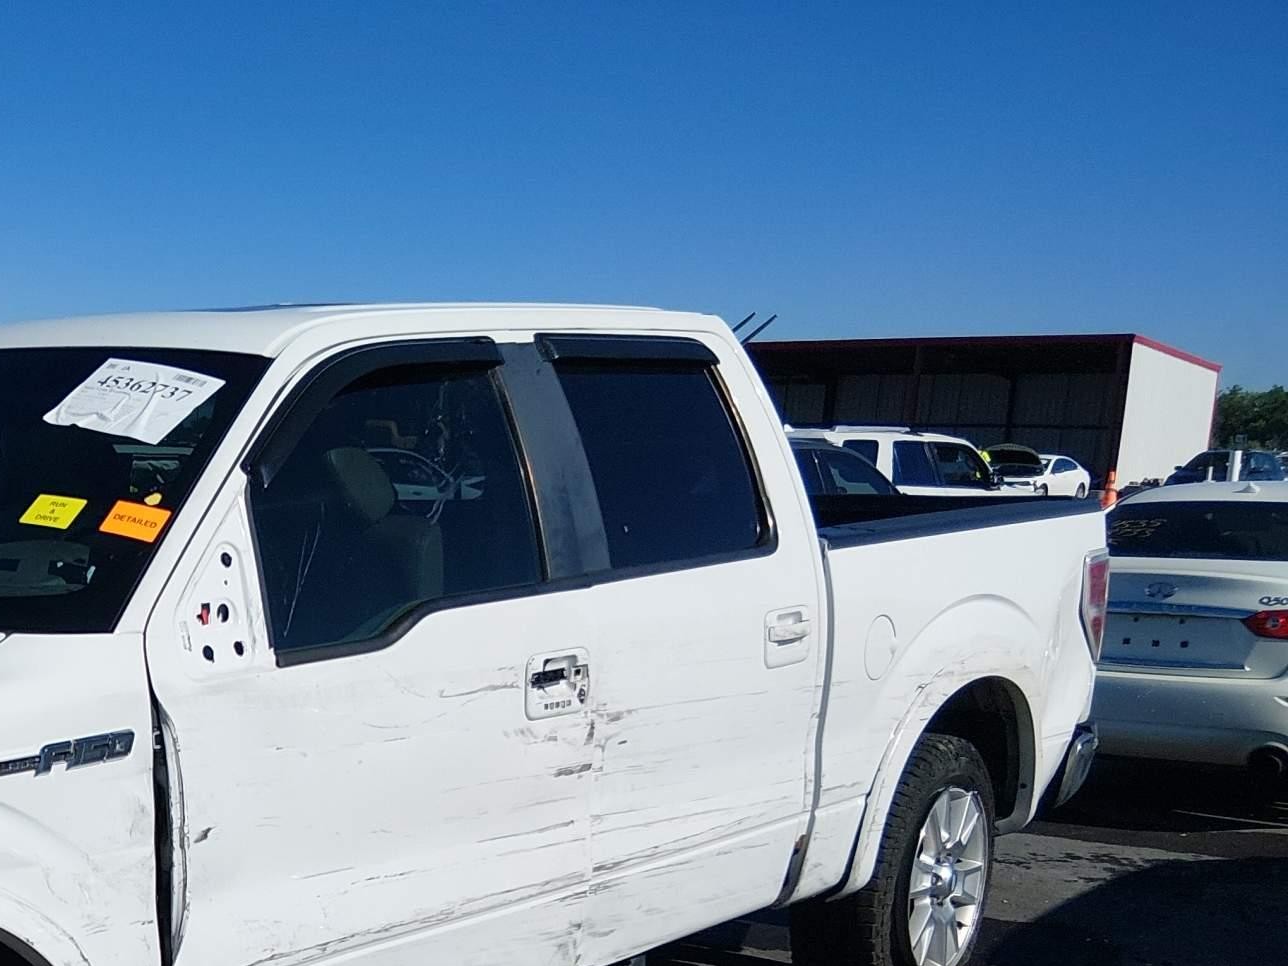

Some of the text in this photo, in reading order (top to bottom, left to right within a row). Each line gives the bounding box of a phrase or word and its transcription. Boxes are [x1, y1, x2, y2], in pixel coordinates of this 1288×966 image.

[98, 375, 193, 402] 45362737
[34, 514, 60, 522] DRIVE
[113, 513, 158, 529] DETAILED
